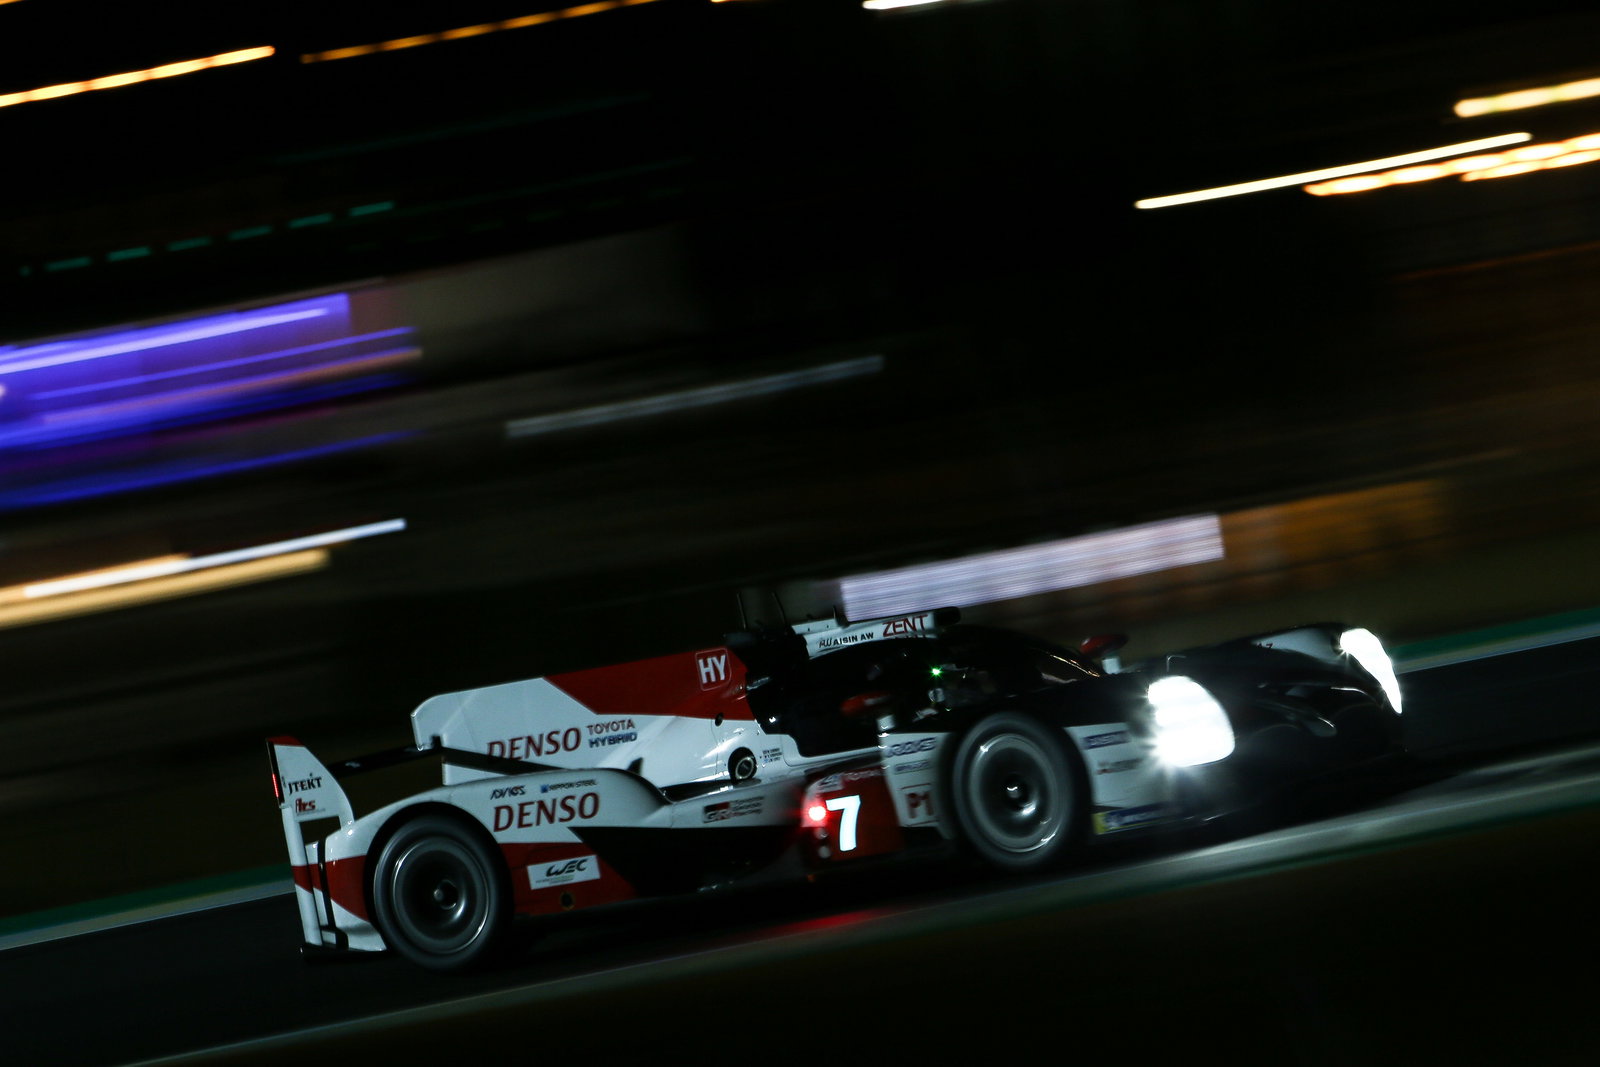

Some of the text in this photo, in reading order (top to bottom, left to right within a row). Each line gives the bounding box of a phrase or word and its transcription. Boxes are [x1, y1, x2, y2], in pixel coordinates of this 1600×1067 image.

[882, 614, 928, 637] ZENT
[833, 635, 858, 646] AISIN
[860, 632, 874, 641] AW
[698, 654, 726, 684] HY
[586, 719, 635, 735] TOYOTA
[487, 727, 582, 761] DENSO
[588, 732, 638, 748] HYBRID
[288, 777, 322, 795] JTEKT
[494, 792, 600, 832] DENSO
[825, 794, 861, 852] 7
[546, 858, 589, 877] WEC
